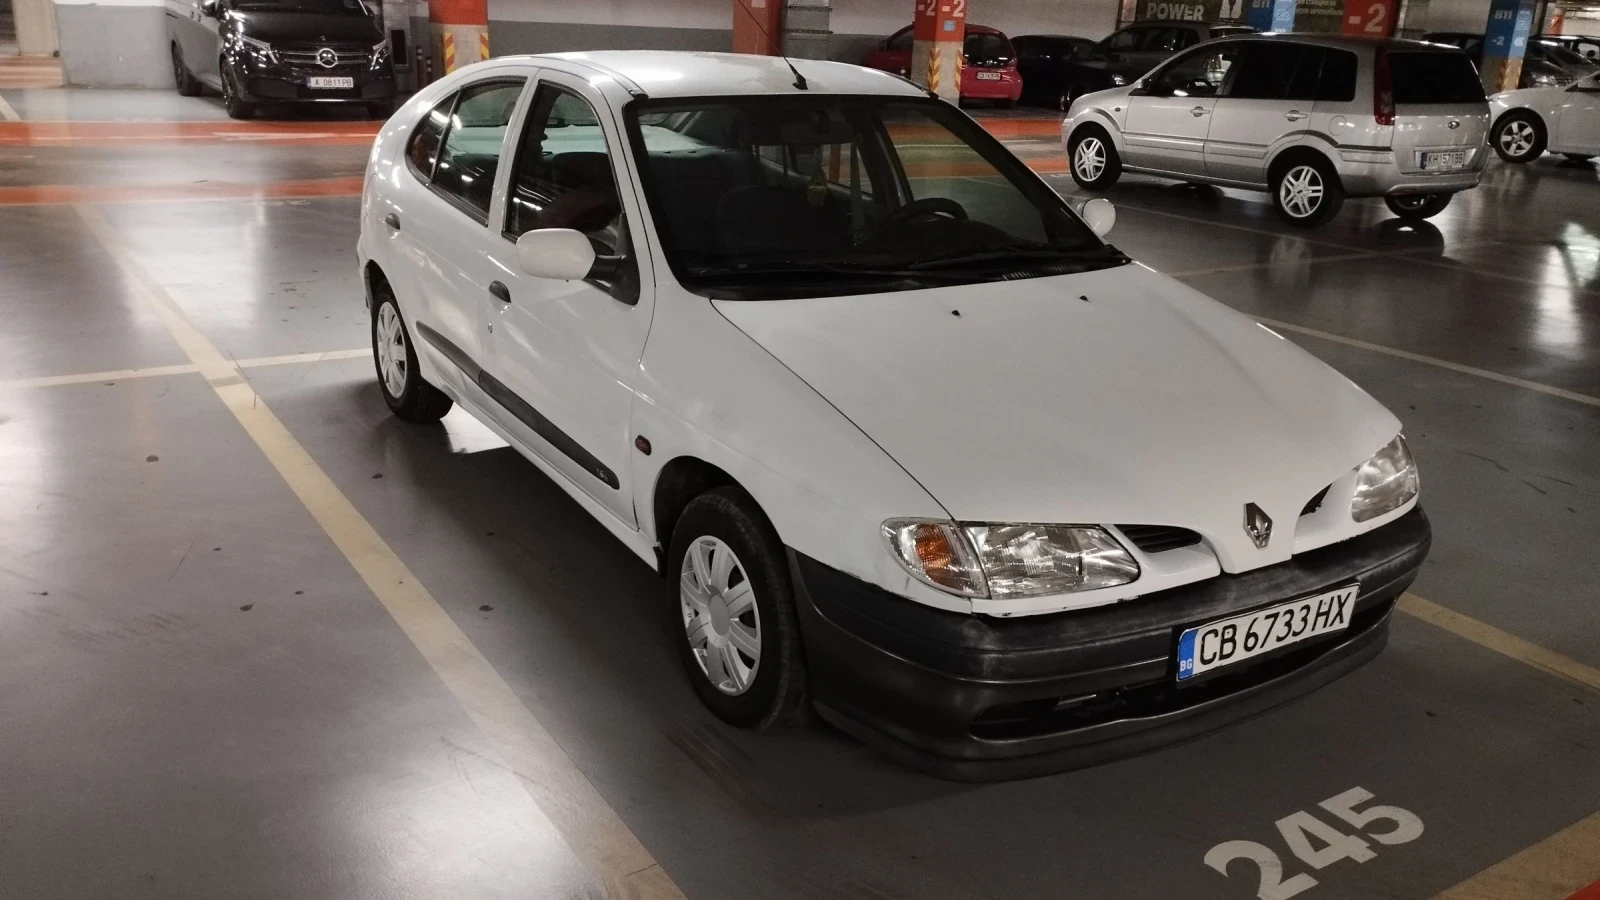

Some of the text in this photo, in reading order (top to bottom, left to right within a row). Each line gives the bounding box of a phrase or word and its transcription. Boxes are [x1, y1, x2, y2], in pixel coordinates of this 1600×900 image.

[941, 0, 965, 17] -2
[1145, 2, 1206, 21] POWER
[1348, 3, 1386, 33] -2
[1492, 35, 1505, 46] -2
[1199, 591, 1352, 666] CB 6733 HX
[1179, 658, 1193, 672] BG
[1203, 785, 1425, 900] 245
